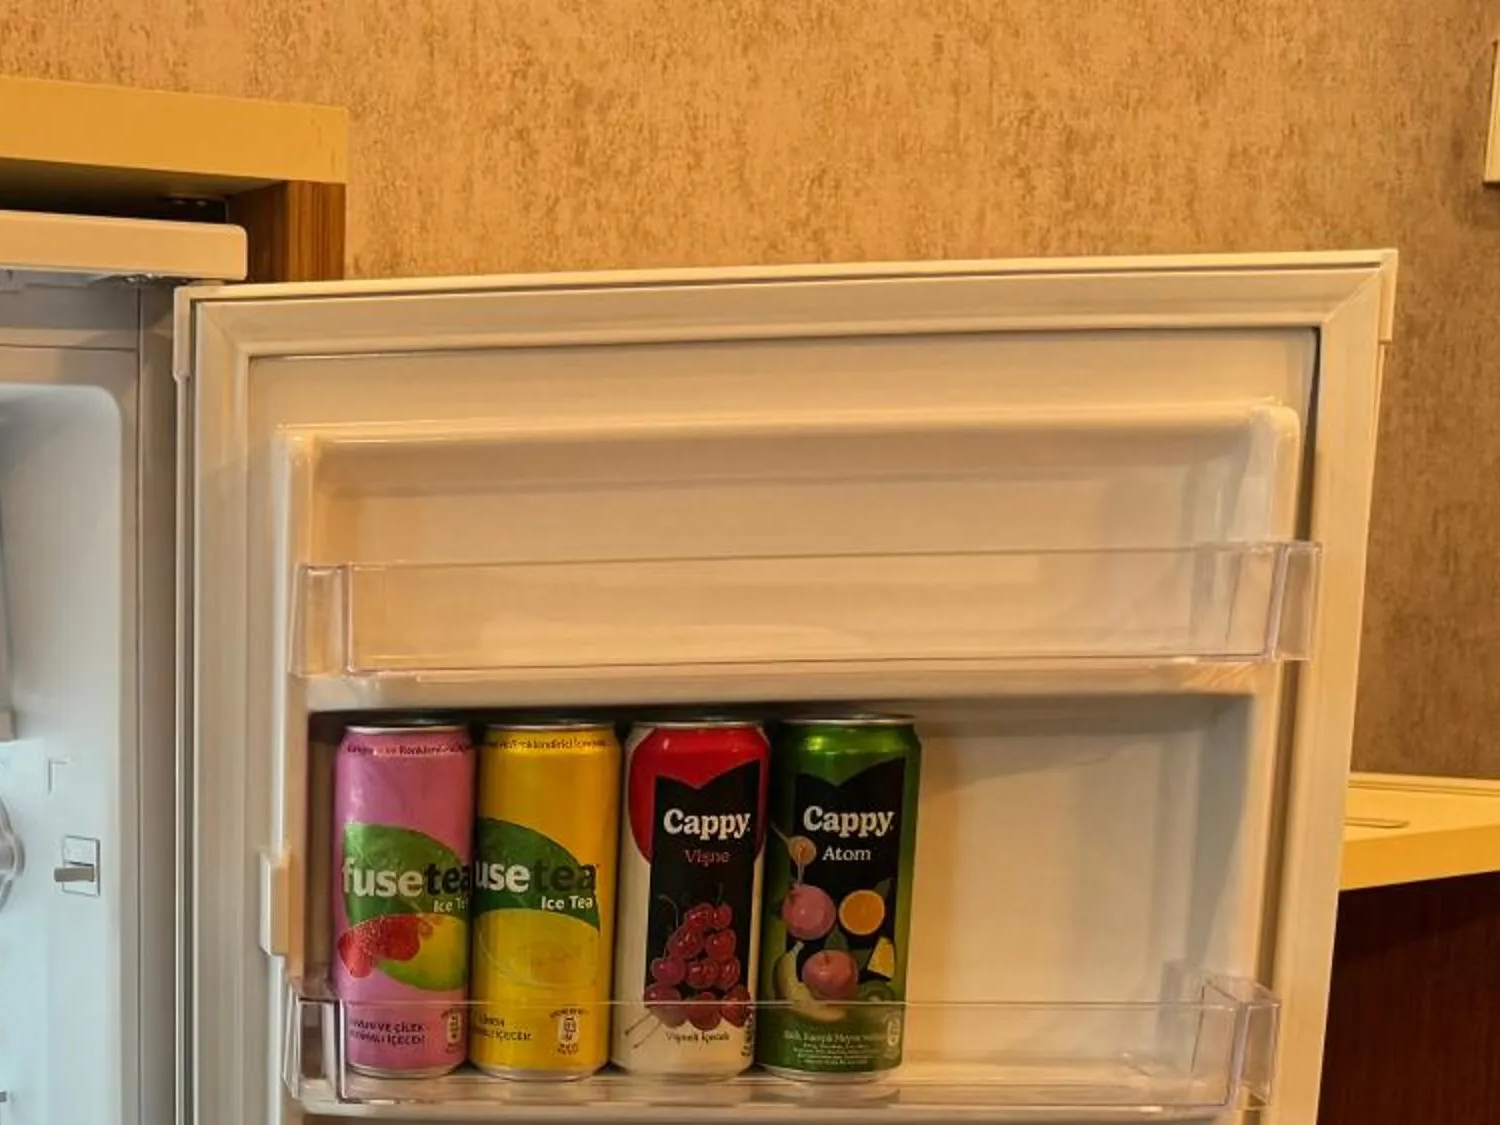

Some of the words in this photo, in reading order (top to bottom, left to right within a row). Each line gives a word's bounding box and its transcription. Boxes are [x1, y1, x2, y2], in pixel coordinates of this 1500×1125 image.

[663, 808, 751, 840] Cappy
[803, 805, 895, 837] Cappy
[822, 846, 871, 861] Atom
[541, 895, 565, 910] Ice
[569, 895, 593, 909] Tea
